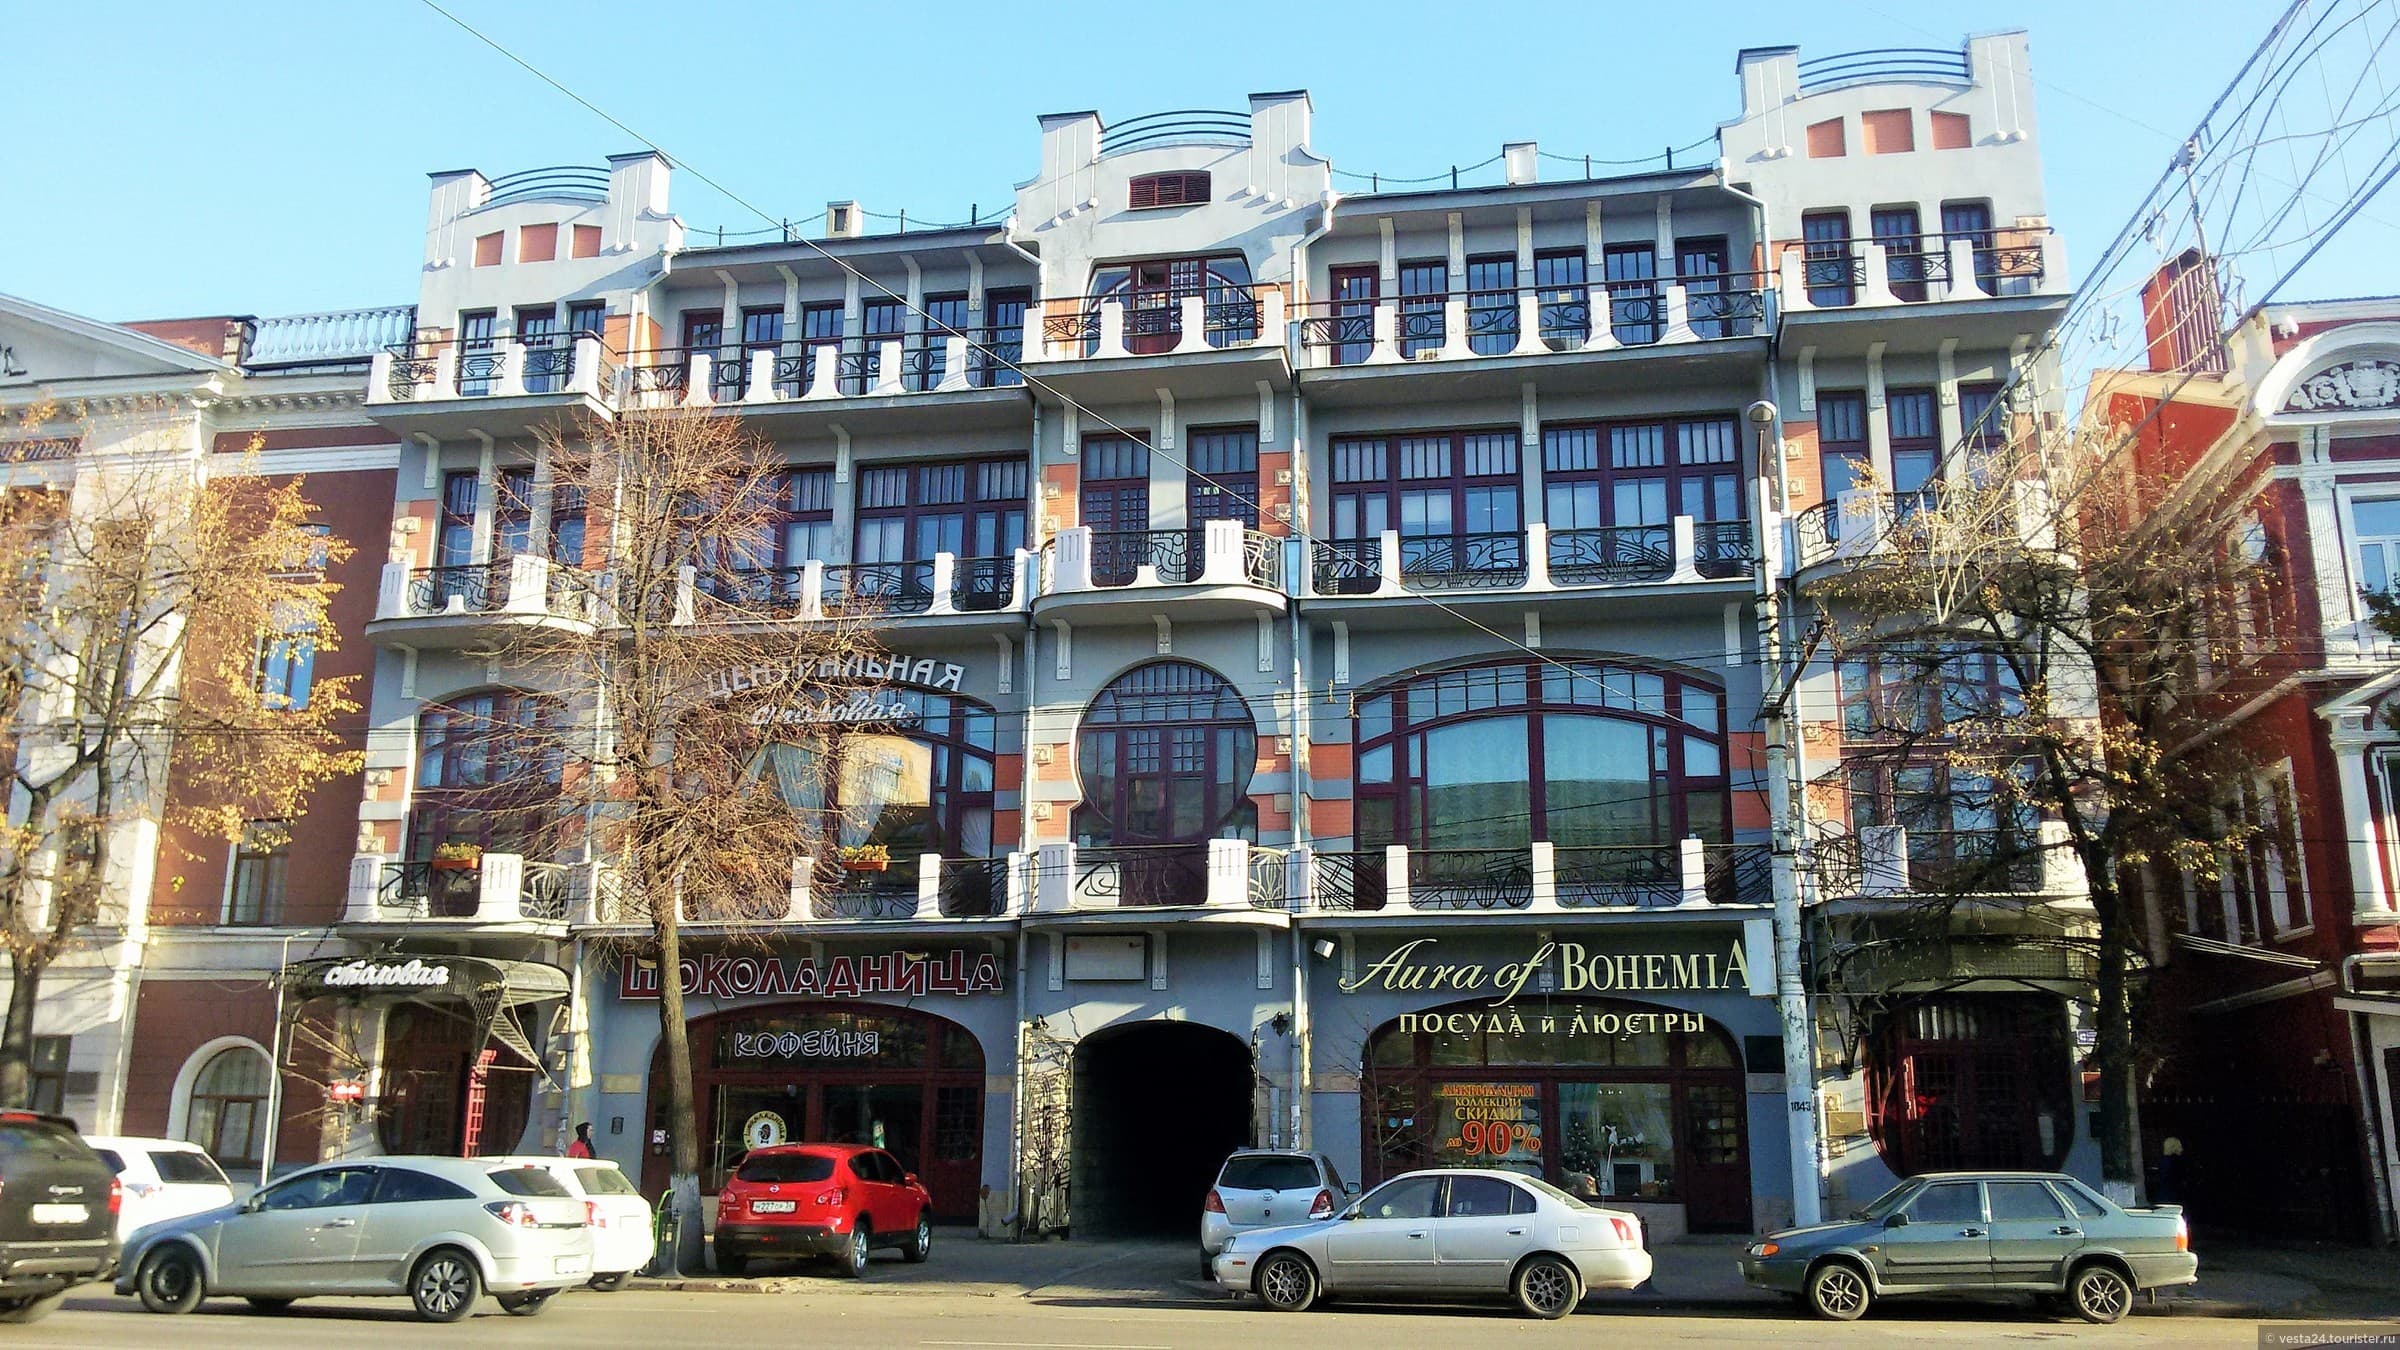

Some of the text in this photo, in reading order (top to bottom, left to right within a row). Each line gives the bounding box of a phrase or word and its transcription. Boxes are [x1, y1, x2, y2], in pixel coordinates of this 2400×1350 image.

[1338, 938, 1751, 1007] Aura of BOHEMIA
[1399, 1011, 1526, 1035] ПОСУДА
[1570, 1011, 1706, 1036] ЛЮСТРЫ
[734, 1028, 880, 1058] КОФЕЙНЯ
[1453, 1106, 1523, 1121] СКИДКИ
[1454, 1097, 1522, 1108] КОЛЛЕКЦИИ
[1462, 1120, 1542, 1156] 90%
